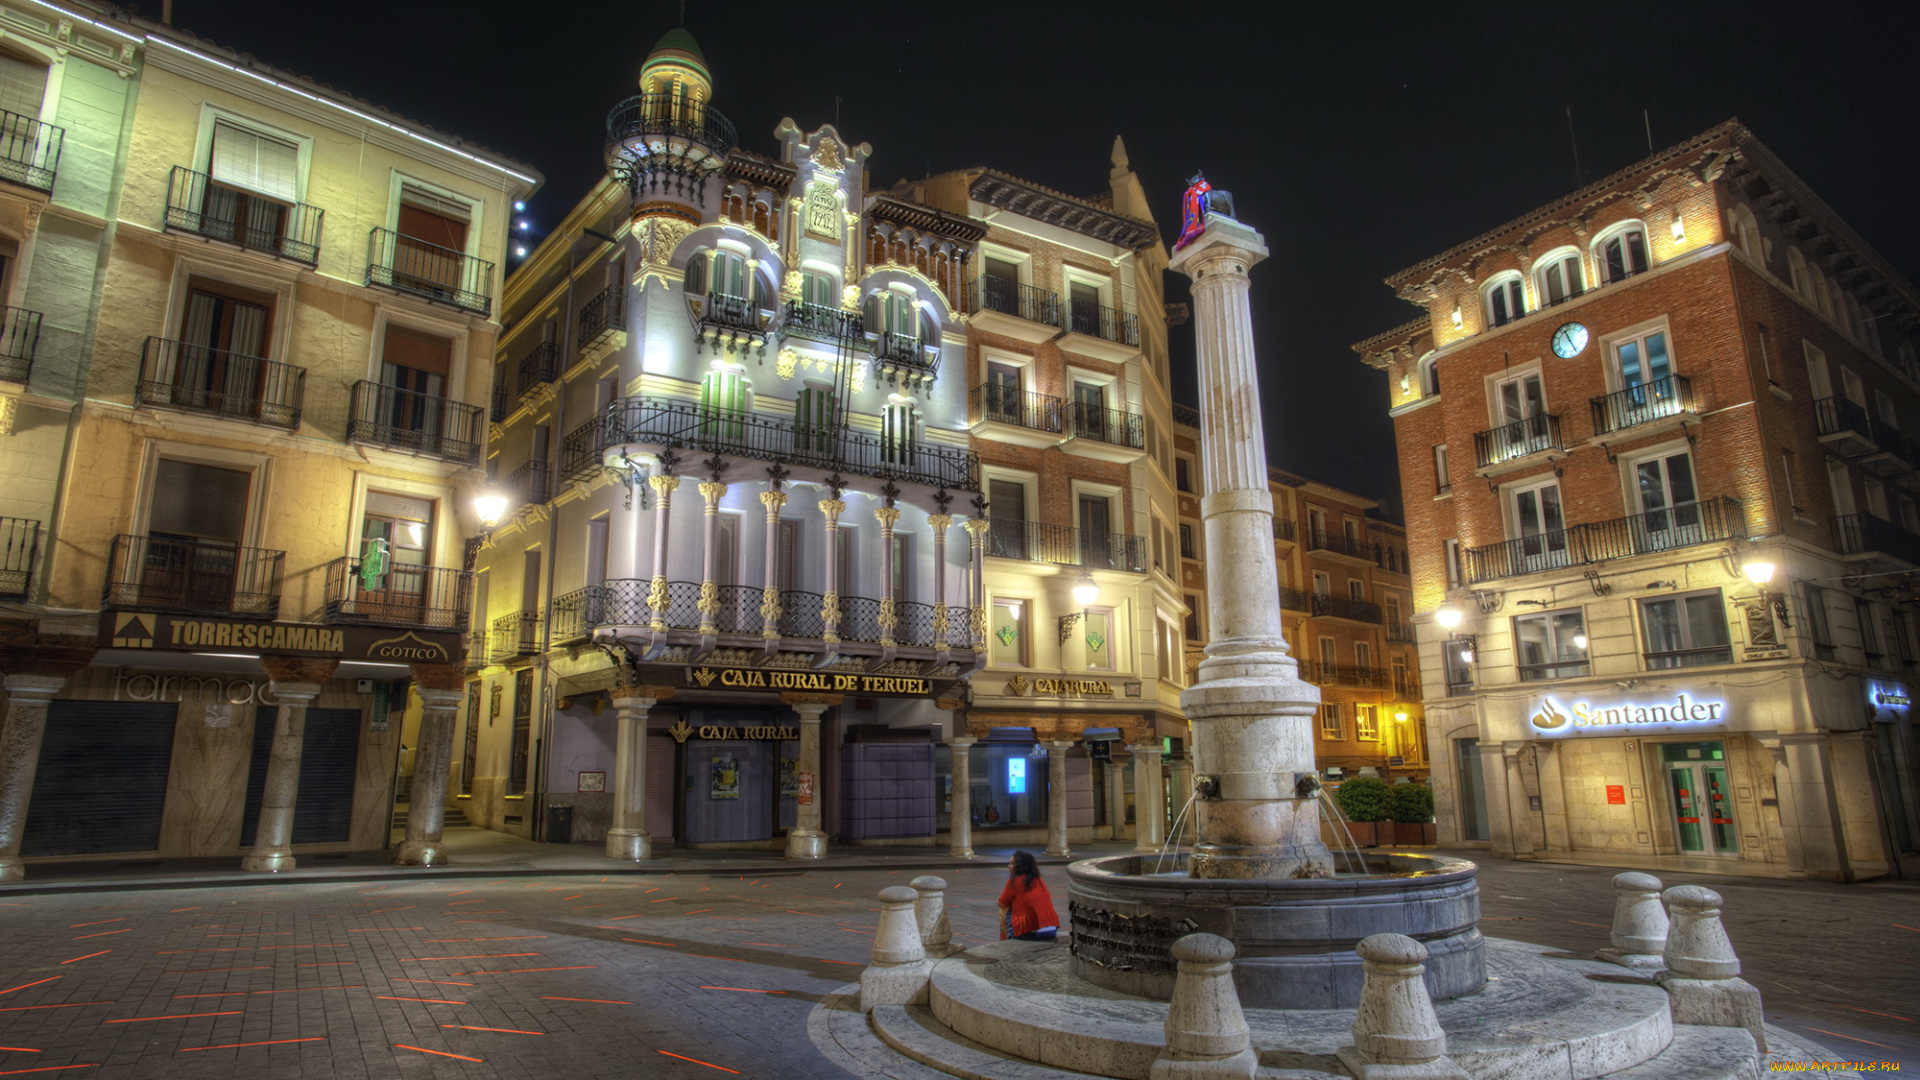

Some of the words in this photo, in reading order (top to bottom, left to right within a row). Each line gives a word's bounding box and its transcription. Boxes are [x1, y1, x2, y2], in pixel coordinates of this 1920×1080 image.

[813, 211, 833, 230] 1912
[169, 620, 344, 652] TORRESCAMARA
[379, 646, 437, 660] GOTICO
[720, 669, 766, 687] CAJA
[769, 671, 831, 690] RURAL
[833, 675, 858, 691] DE
[861, 676, 929, 694] TERUEL
[1572, 694, 1721, 727] Santander
[699, 725, 740, 741] CAJA
[743, 725, 798, 740] RURAL
